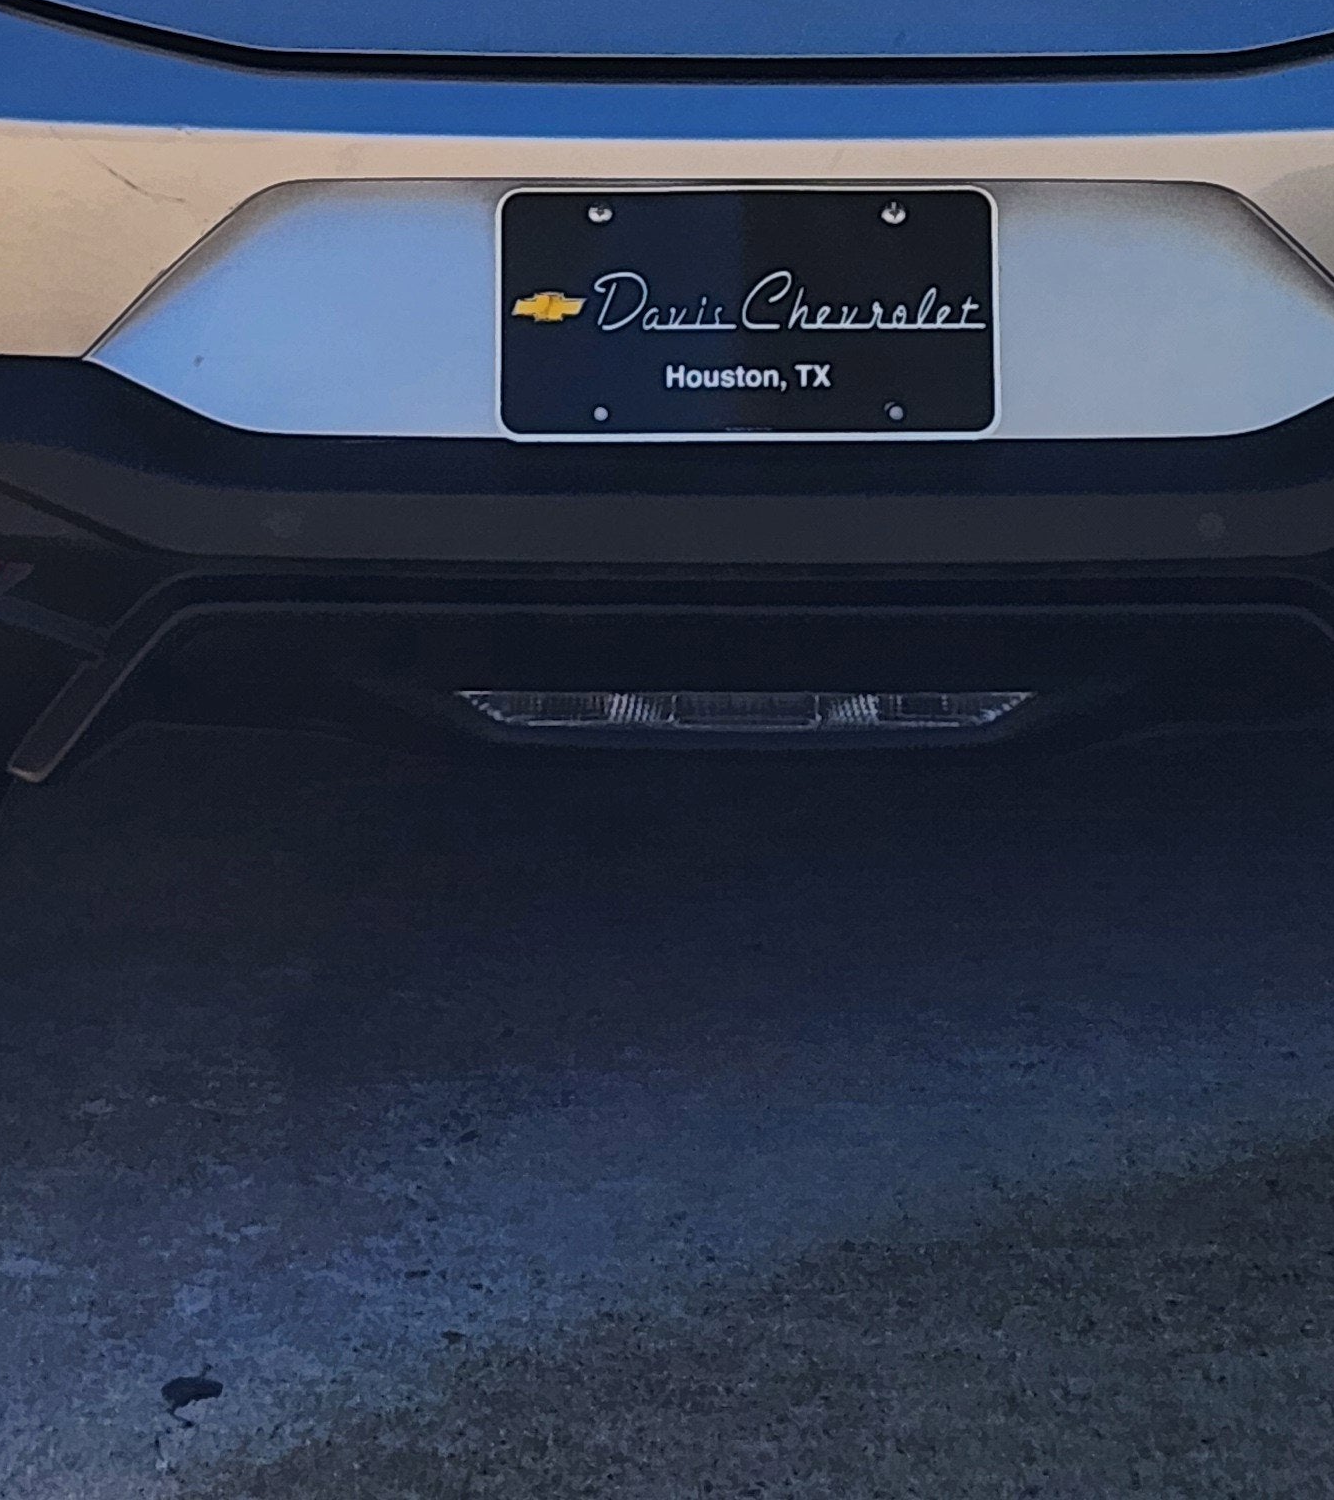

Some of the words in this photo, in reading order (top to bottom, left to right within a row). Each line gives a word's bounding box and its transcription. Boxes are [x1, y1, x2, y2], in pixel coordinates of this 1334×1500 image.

[594, 271, 737, 331] Davis
[741, 270, 986, 330] Chevrolet
[666, 365, 787, 391] Houston,
[795, 365, 831, 388] TX
